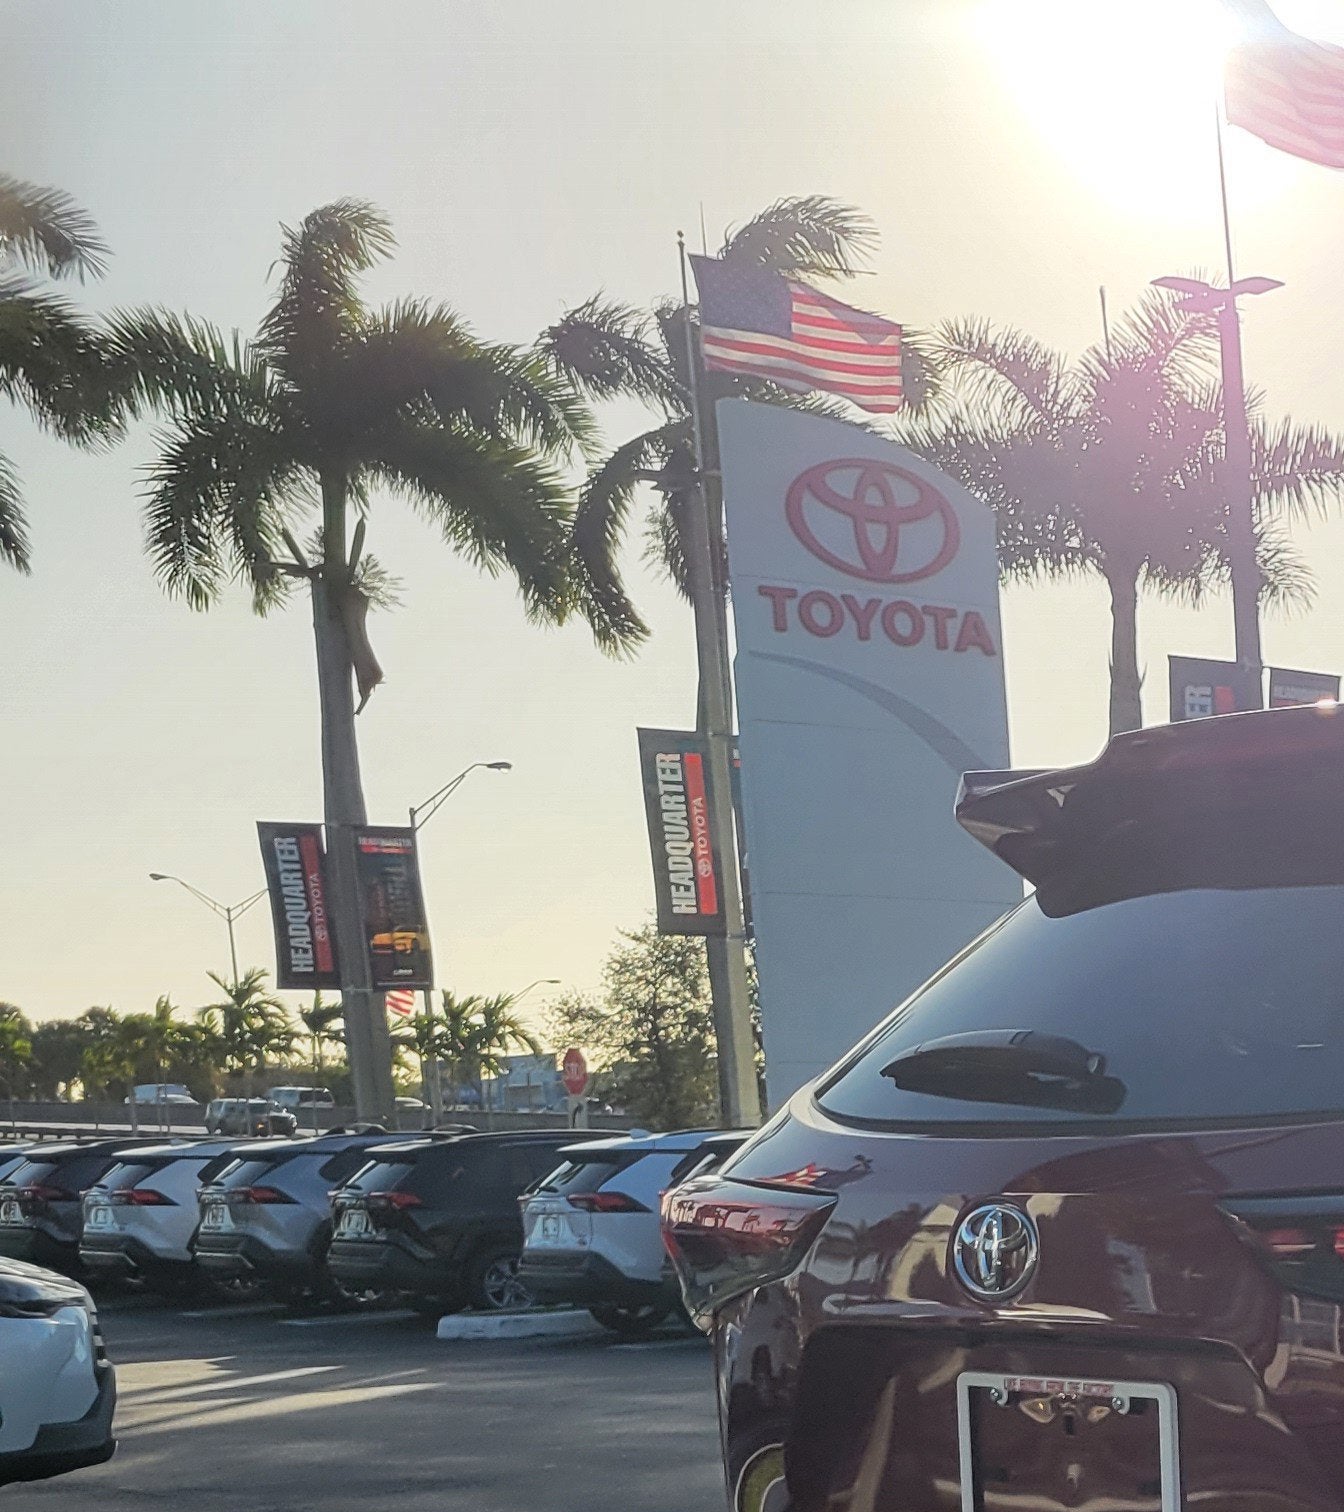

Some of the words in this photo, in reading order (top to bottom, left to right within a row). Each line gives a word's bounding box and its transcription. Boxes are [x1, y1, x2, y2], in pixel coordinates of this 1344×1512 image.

[758, 585, 997, 657] TOYOTA
[655, 752, 698, 915] HEADQUARTER
[691, 797, 709, 856] TOYOTA
[273, 836, 315, 974] HEADQUARTER
[308, 873, 325, 927] TOYOTA
